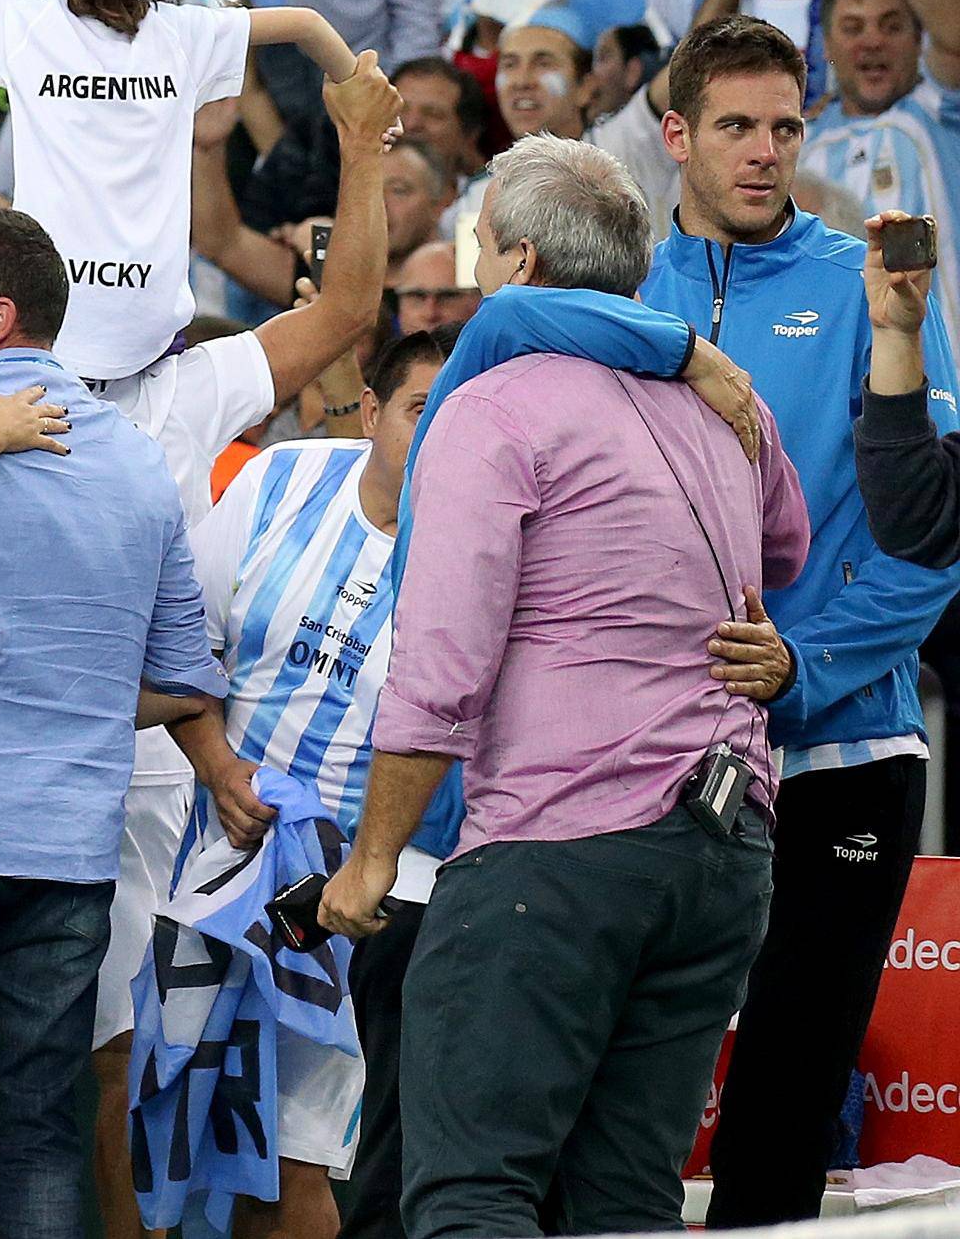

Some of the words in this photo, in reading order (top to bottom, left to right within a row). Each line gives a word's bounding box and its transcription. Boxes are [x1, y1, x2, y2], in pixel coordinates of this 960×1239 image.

[38, 73, 178, 101] ARGENTINA
[68, 258, 153, 289] VICKY
[772, 323, 820, 338] Topper
[335, 584, 374, 610] Topper
[299, 615, 324, 634] San
[832, 845, 879, 863] Topper
[883, 927, 960, 971] dec
[864, 1070, 960, 1114] Adec
